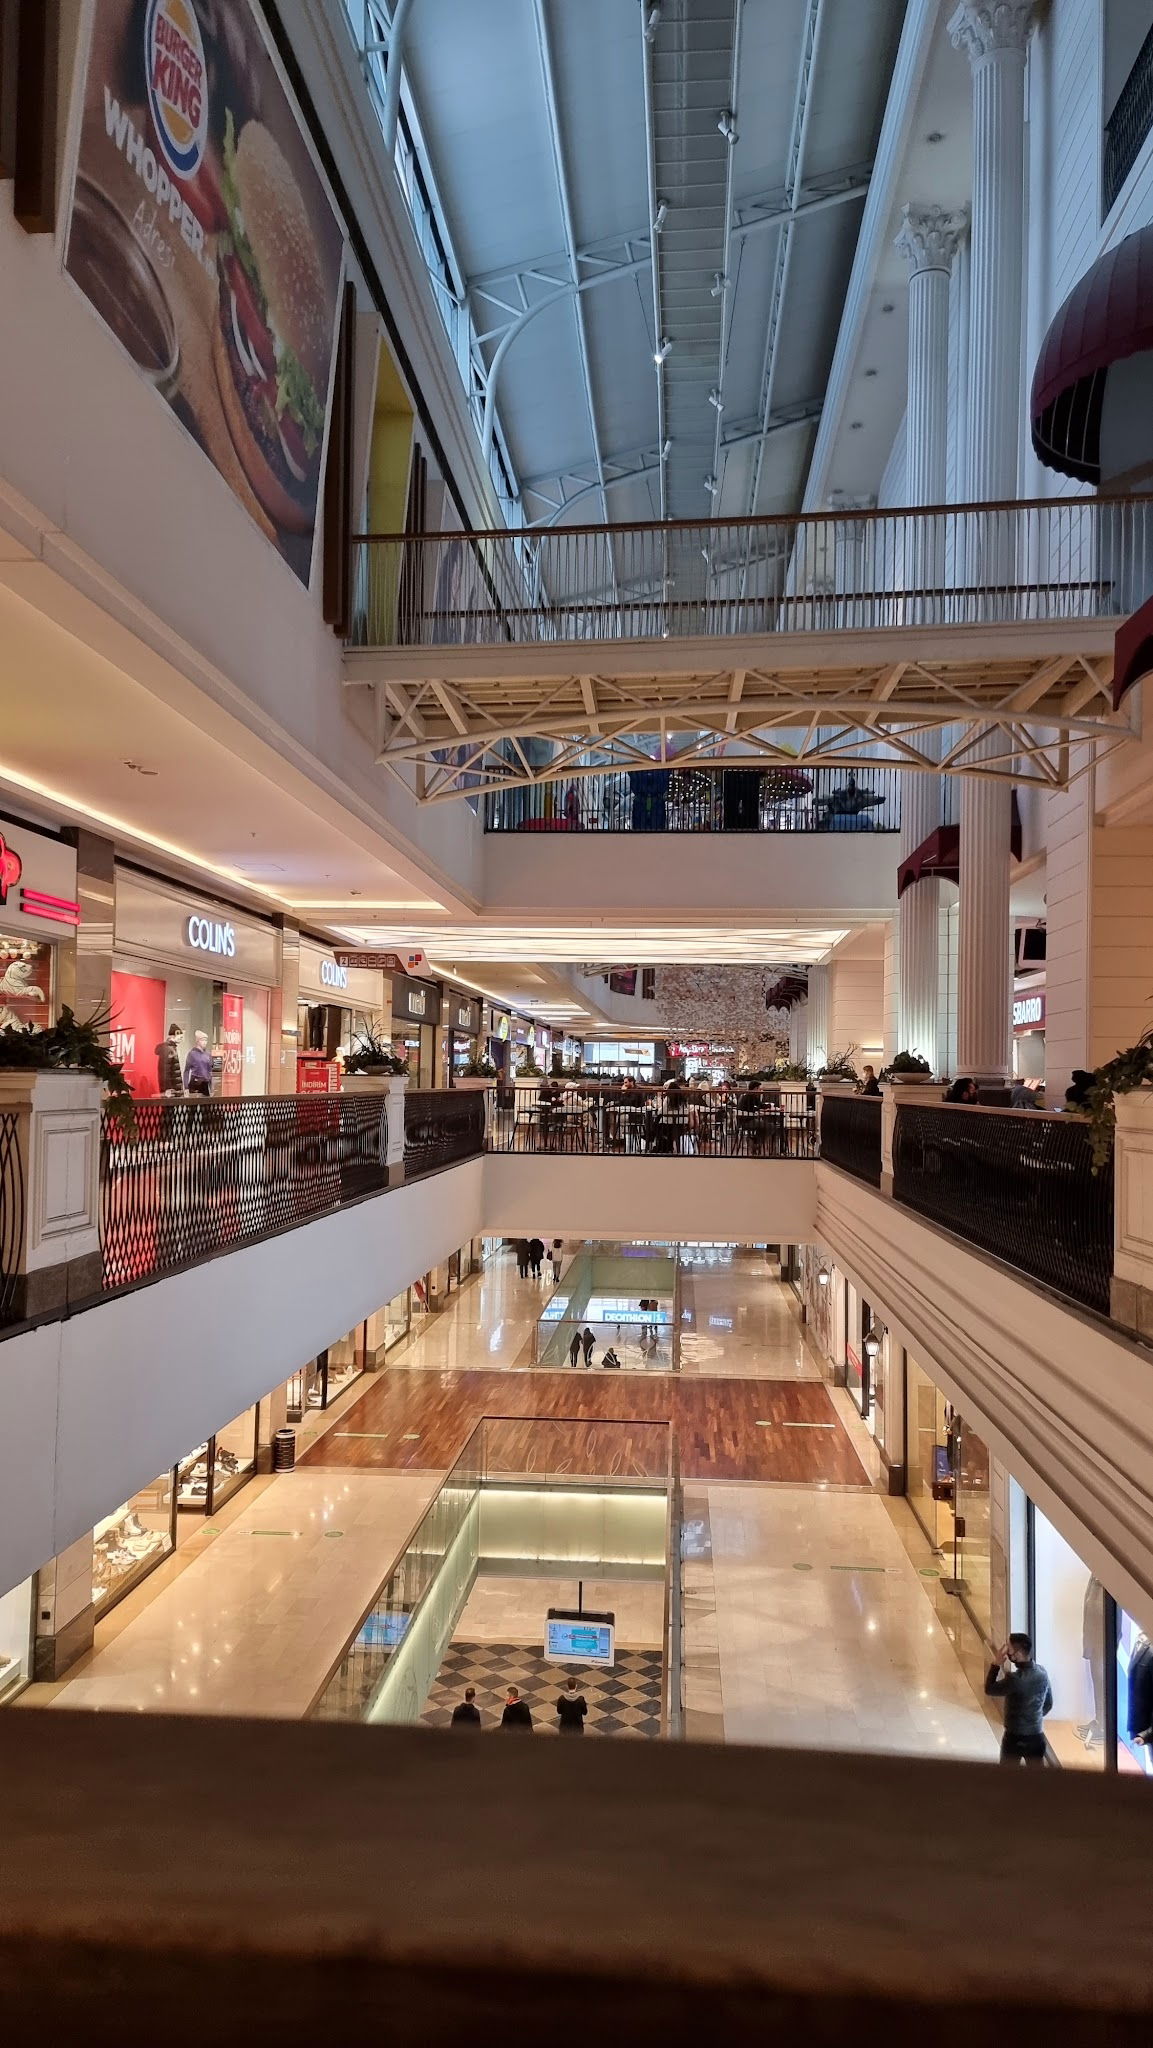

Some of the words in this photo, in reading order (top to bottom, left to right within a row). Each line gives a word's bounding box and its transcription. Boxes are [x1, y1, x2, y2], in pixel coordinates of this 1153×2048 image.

[155, 13, 202, 83] BURGER
[152, 51, 202, 129] KING
[188, 916, 235, 957] COLIN'S
[605, 1312, 652, 1323] DECATHLON
